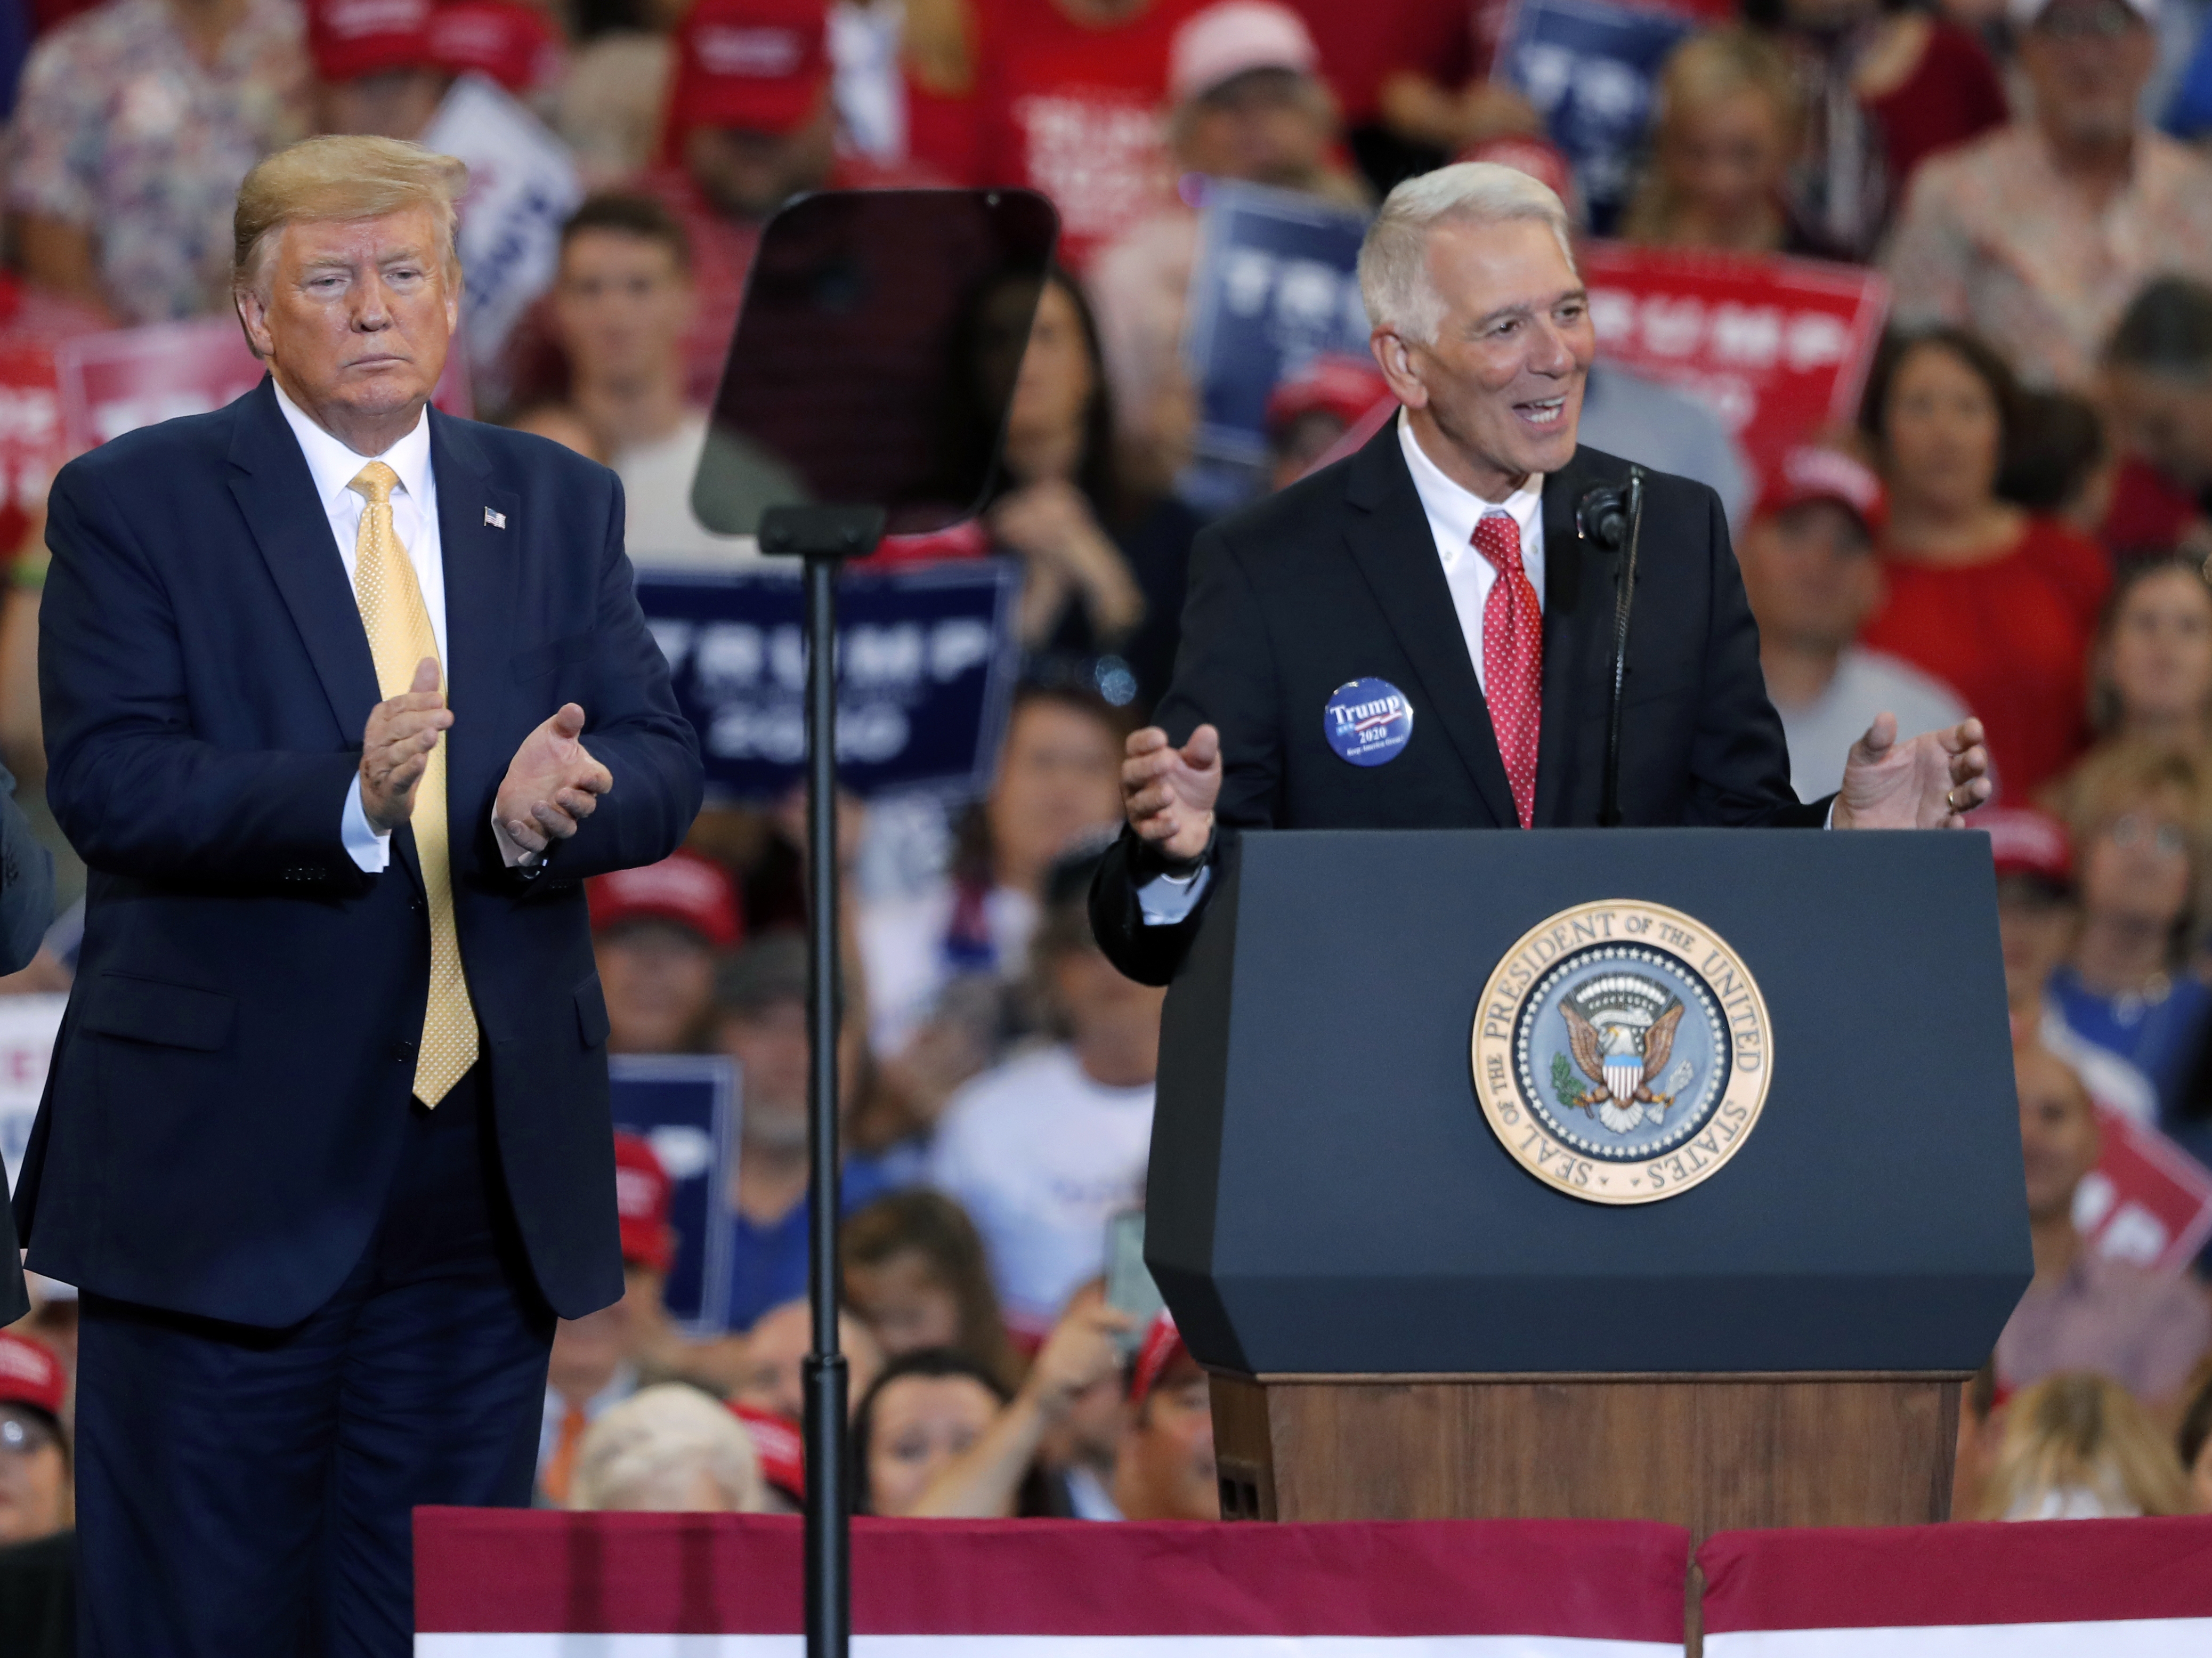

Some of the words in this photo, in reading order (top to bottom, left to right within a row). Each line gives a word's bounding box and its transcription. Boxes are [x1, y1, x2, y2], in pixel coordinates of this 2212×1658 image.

[1330, 695, 1400, 724] Trump
[1359, 726, 1387, 744] 2020
[1624, 915, 1653, 934] OF
[1658, 921, 1695, 953] THE
[1484, 912, 1615, 1041] PRESIDENT
[1700, 949, 1761, 1072] UNITED
[1486, 1053, 1508, 1094] THE
[1496, 1100, 1520, 1126] OF
[1517, 1122, 1593, 1186] SEAL
[1647, 1099, 1747, 1188] STATES
